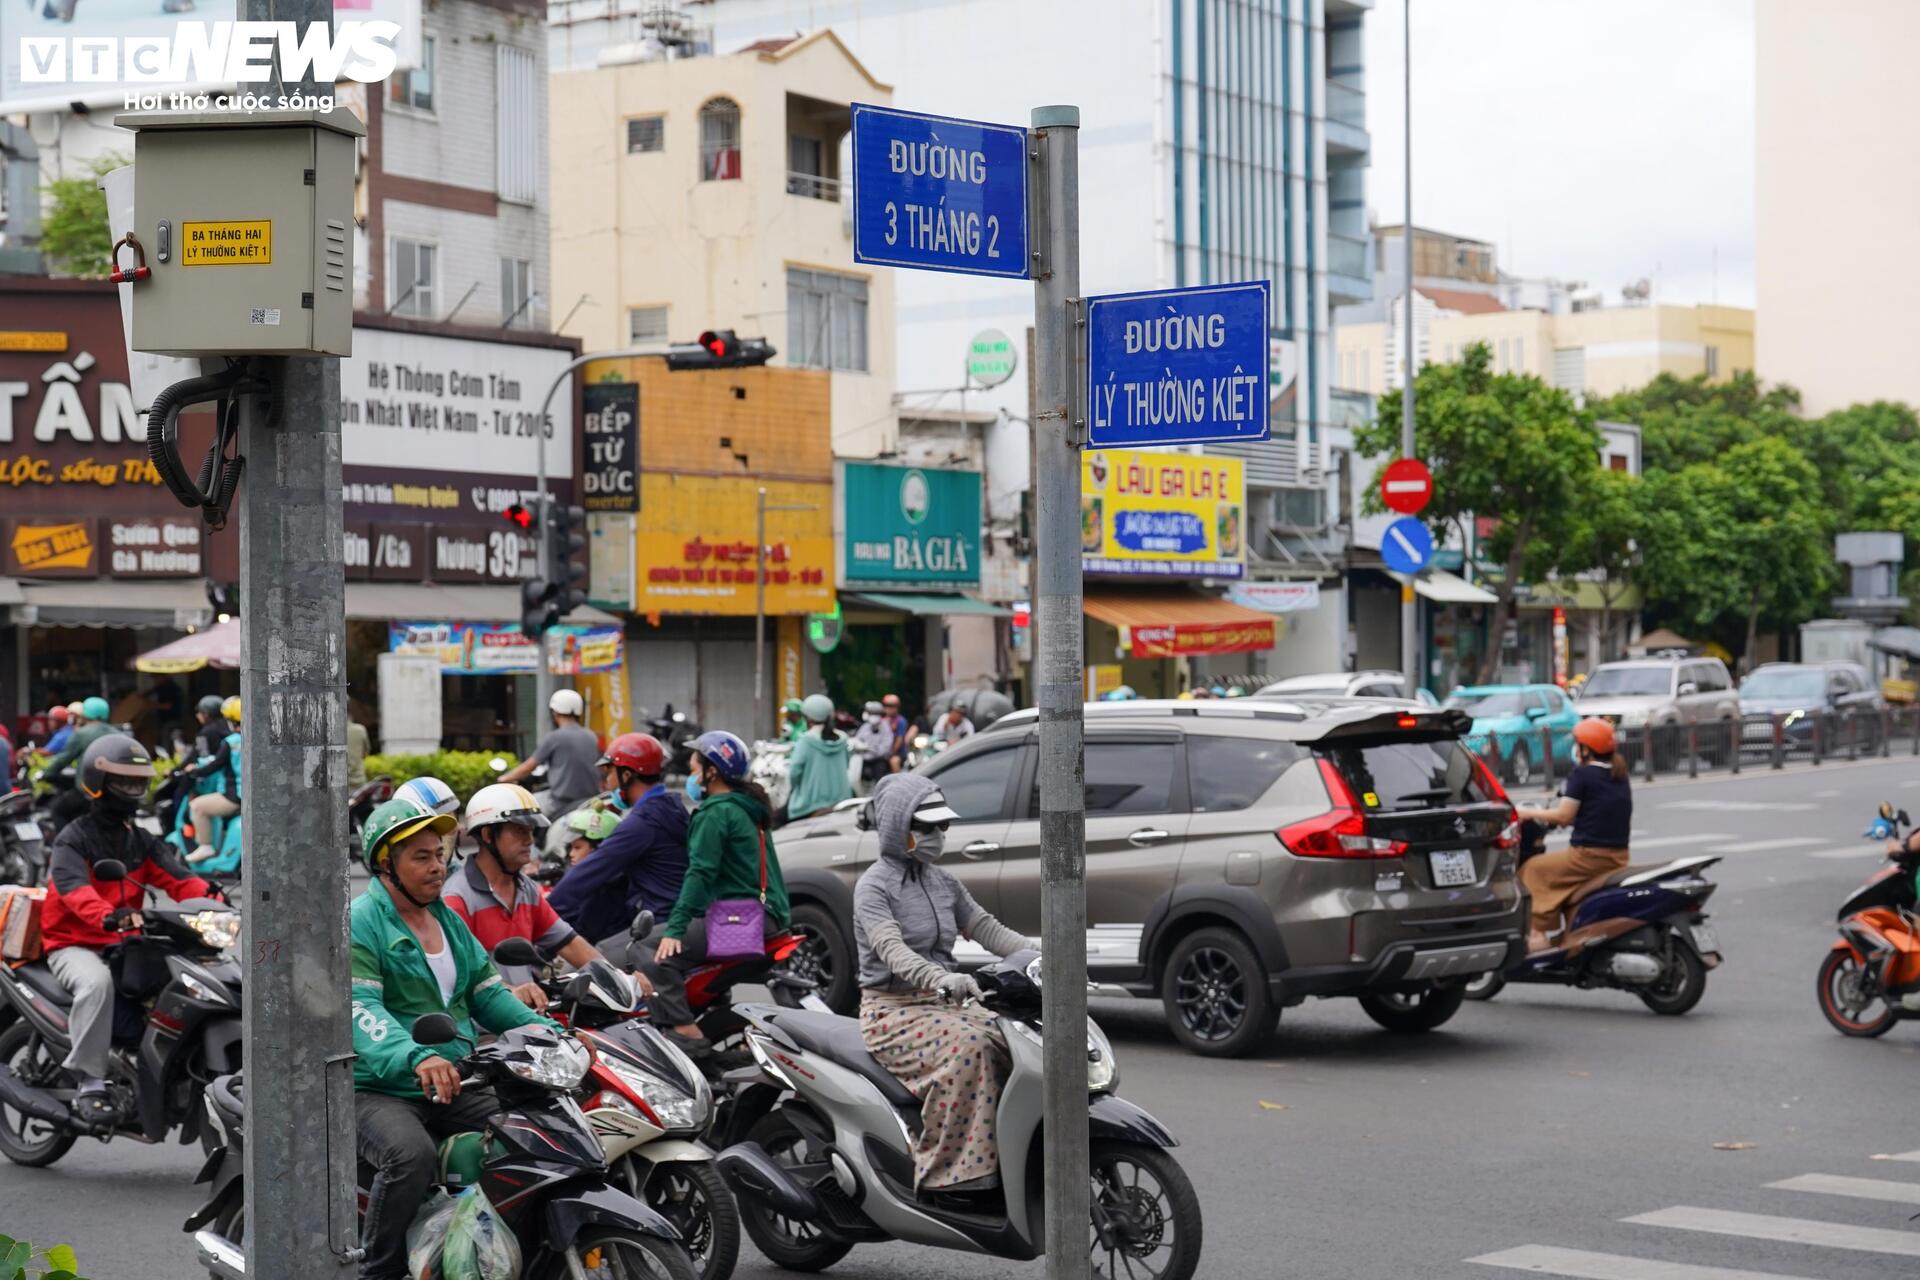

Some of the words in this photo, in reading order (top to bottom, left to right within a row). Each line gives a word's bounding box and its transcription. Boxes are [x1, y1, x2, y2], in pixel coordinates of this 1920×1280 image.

[889, 132, 987, 184] ĐƯỜNG
[192, 230, 205, 241] BA
[208, 227, 242, 241] THÁNG
[245, 229, 262, 240] HAI
[884, 201, 898, 246] 3
[905, 196, 981, 256] THÁNG
[987, 214, 1001, 259] 2
[187, 245, 198, 258] LÝ
[201, 242, 236, 258] THƯỜNG
[239, 243, 259, 258] KIỆT
[262, 246, 267, 256] 1
[1124, 305, 1226, 354] ĐƯỜNG
[449, 369, 484, 398] Cơm
[1095, 369, 1117, 428] LÝ
[1124, 366, 1206, 425] THƯỜNG
[1212, 364, 1259, 431] KIỆT
[443, 405, 478, 433] Nam
[584, 402, 632, 433] BẾP
[590, 435, 626, 464] TỪ
[583, 464, 634, 493] ĐỨC
[352, 1000, 389, 1042] rab
